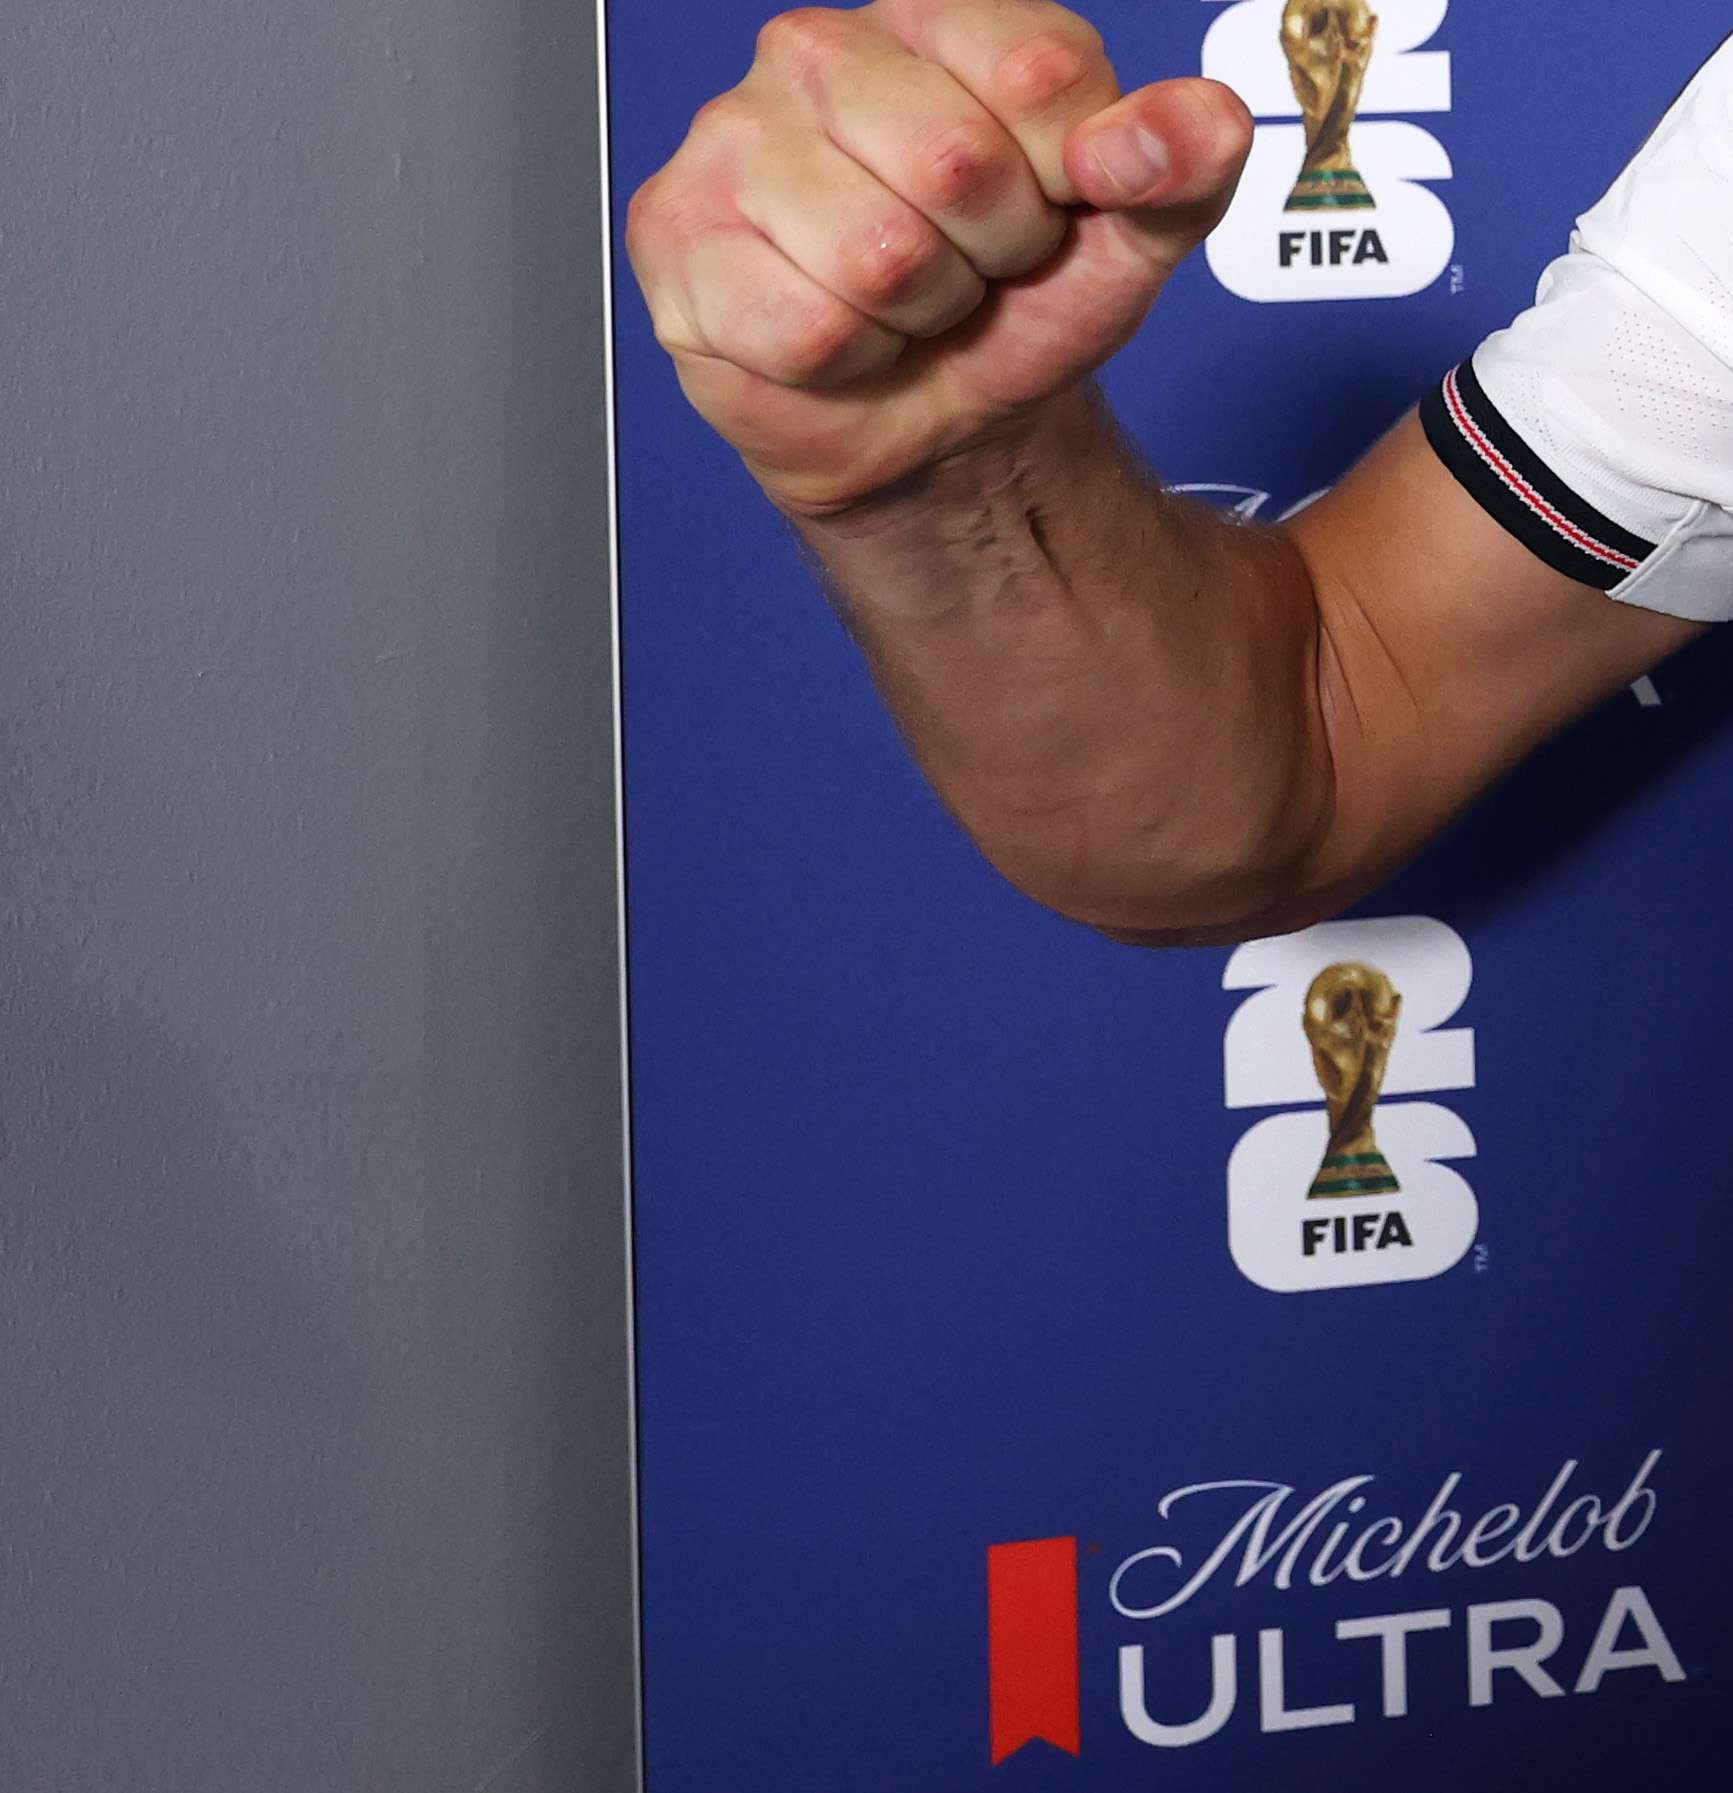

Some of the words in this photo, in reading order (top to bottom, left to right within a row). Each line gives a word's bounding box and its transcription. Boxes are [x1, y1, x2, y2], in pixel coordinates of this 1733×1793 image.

[1280, 230, 1388, 267] FIFA
[1303, 1212, 1412, 1256] FIFA
[1110, 1450, 1661, 1618] Michelob
[1119, 1587, 1685, 1747] ULTRA
